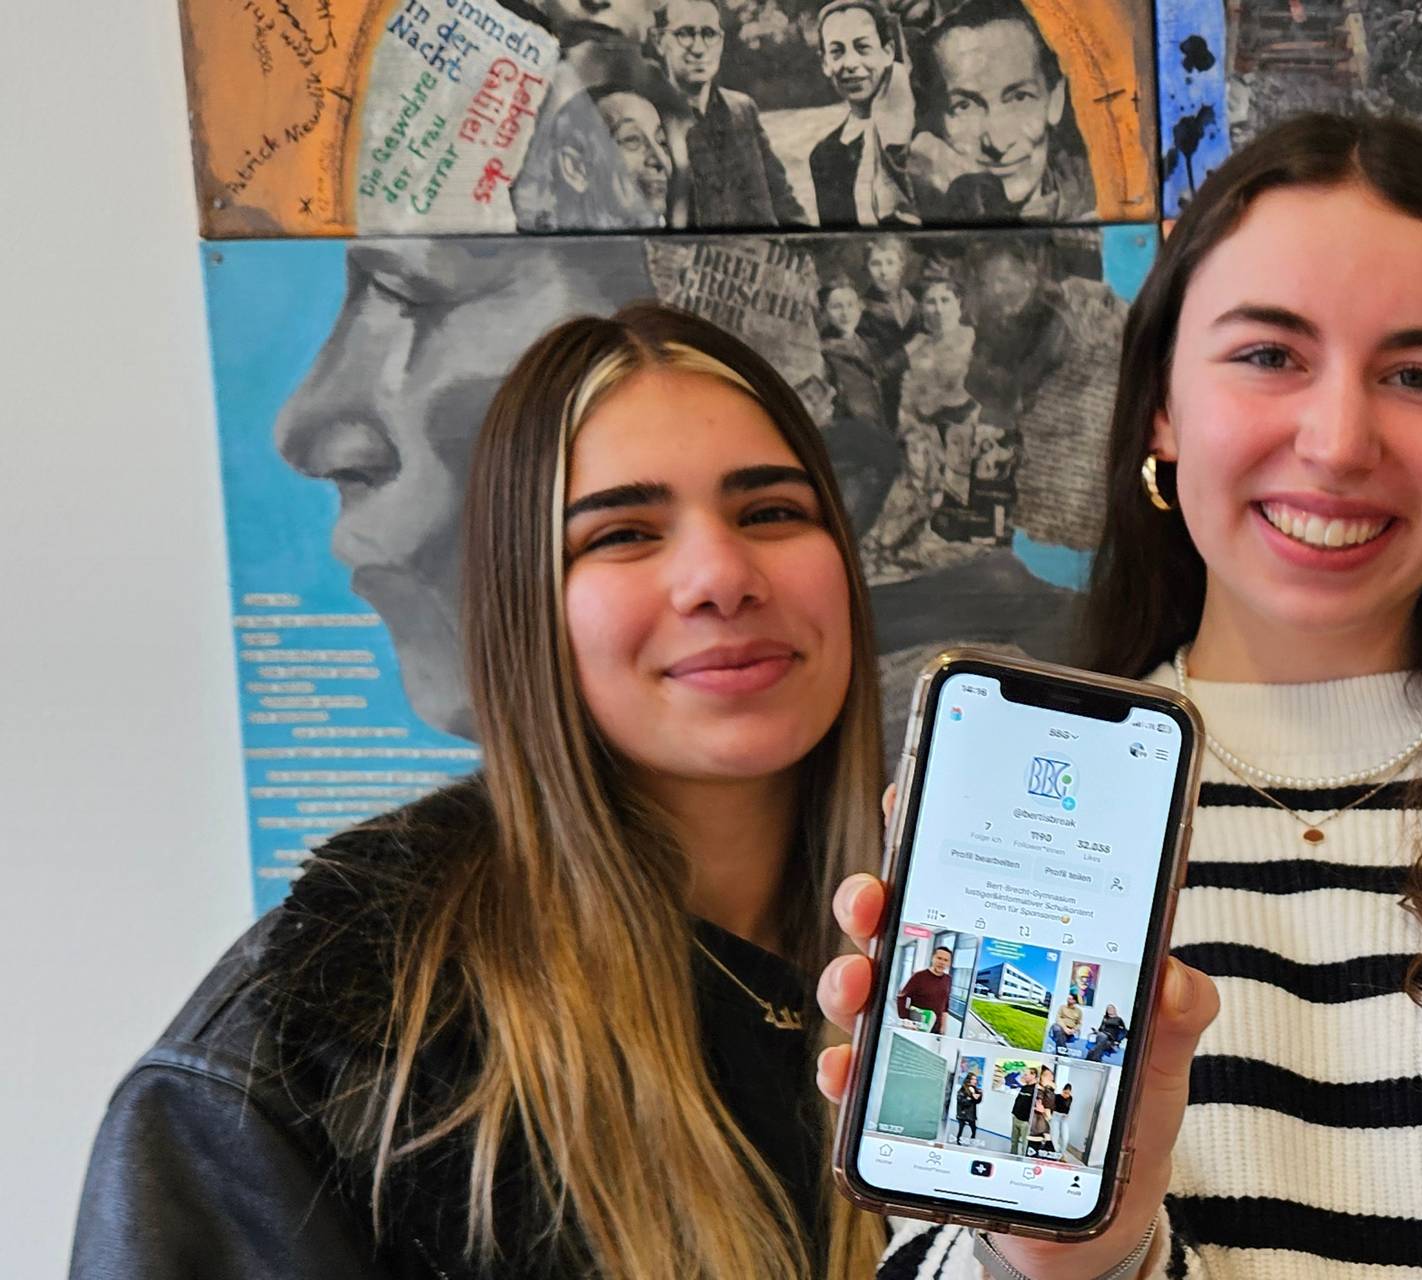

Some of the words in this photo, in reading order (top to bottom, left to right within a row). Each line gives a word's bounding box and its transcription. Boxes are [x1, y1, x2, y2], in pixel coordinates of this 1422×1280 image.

[387, 15, 461, 82] Nacht
[437, 19, 480, 57] der
[359, 168, 382, 197] Die
[372, 71, 437, 163] Gewehre
[408, 114, 446, 159] Frau
[493, 73, 543, 148] Leben
[225, 133, 280, 194] Patrick
[411, 143, 459, 215] Carrar
[473, 158, 511, 204] des
